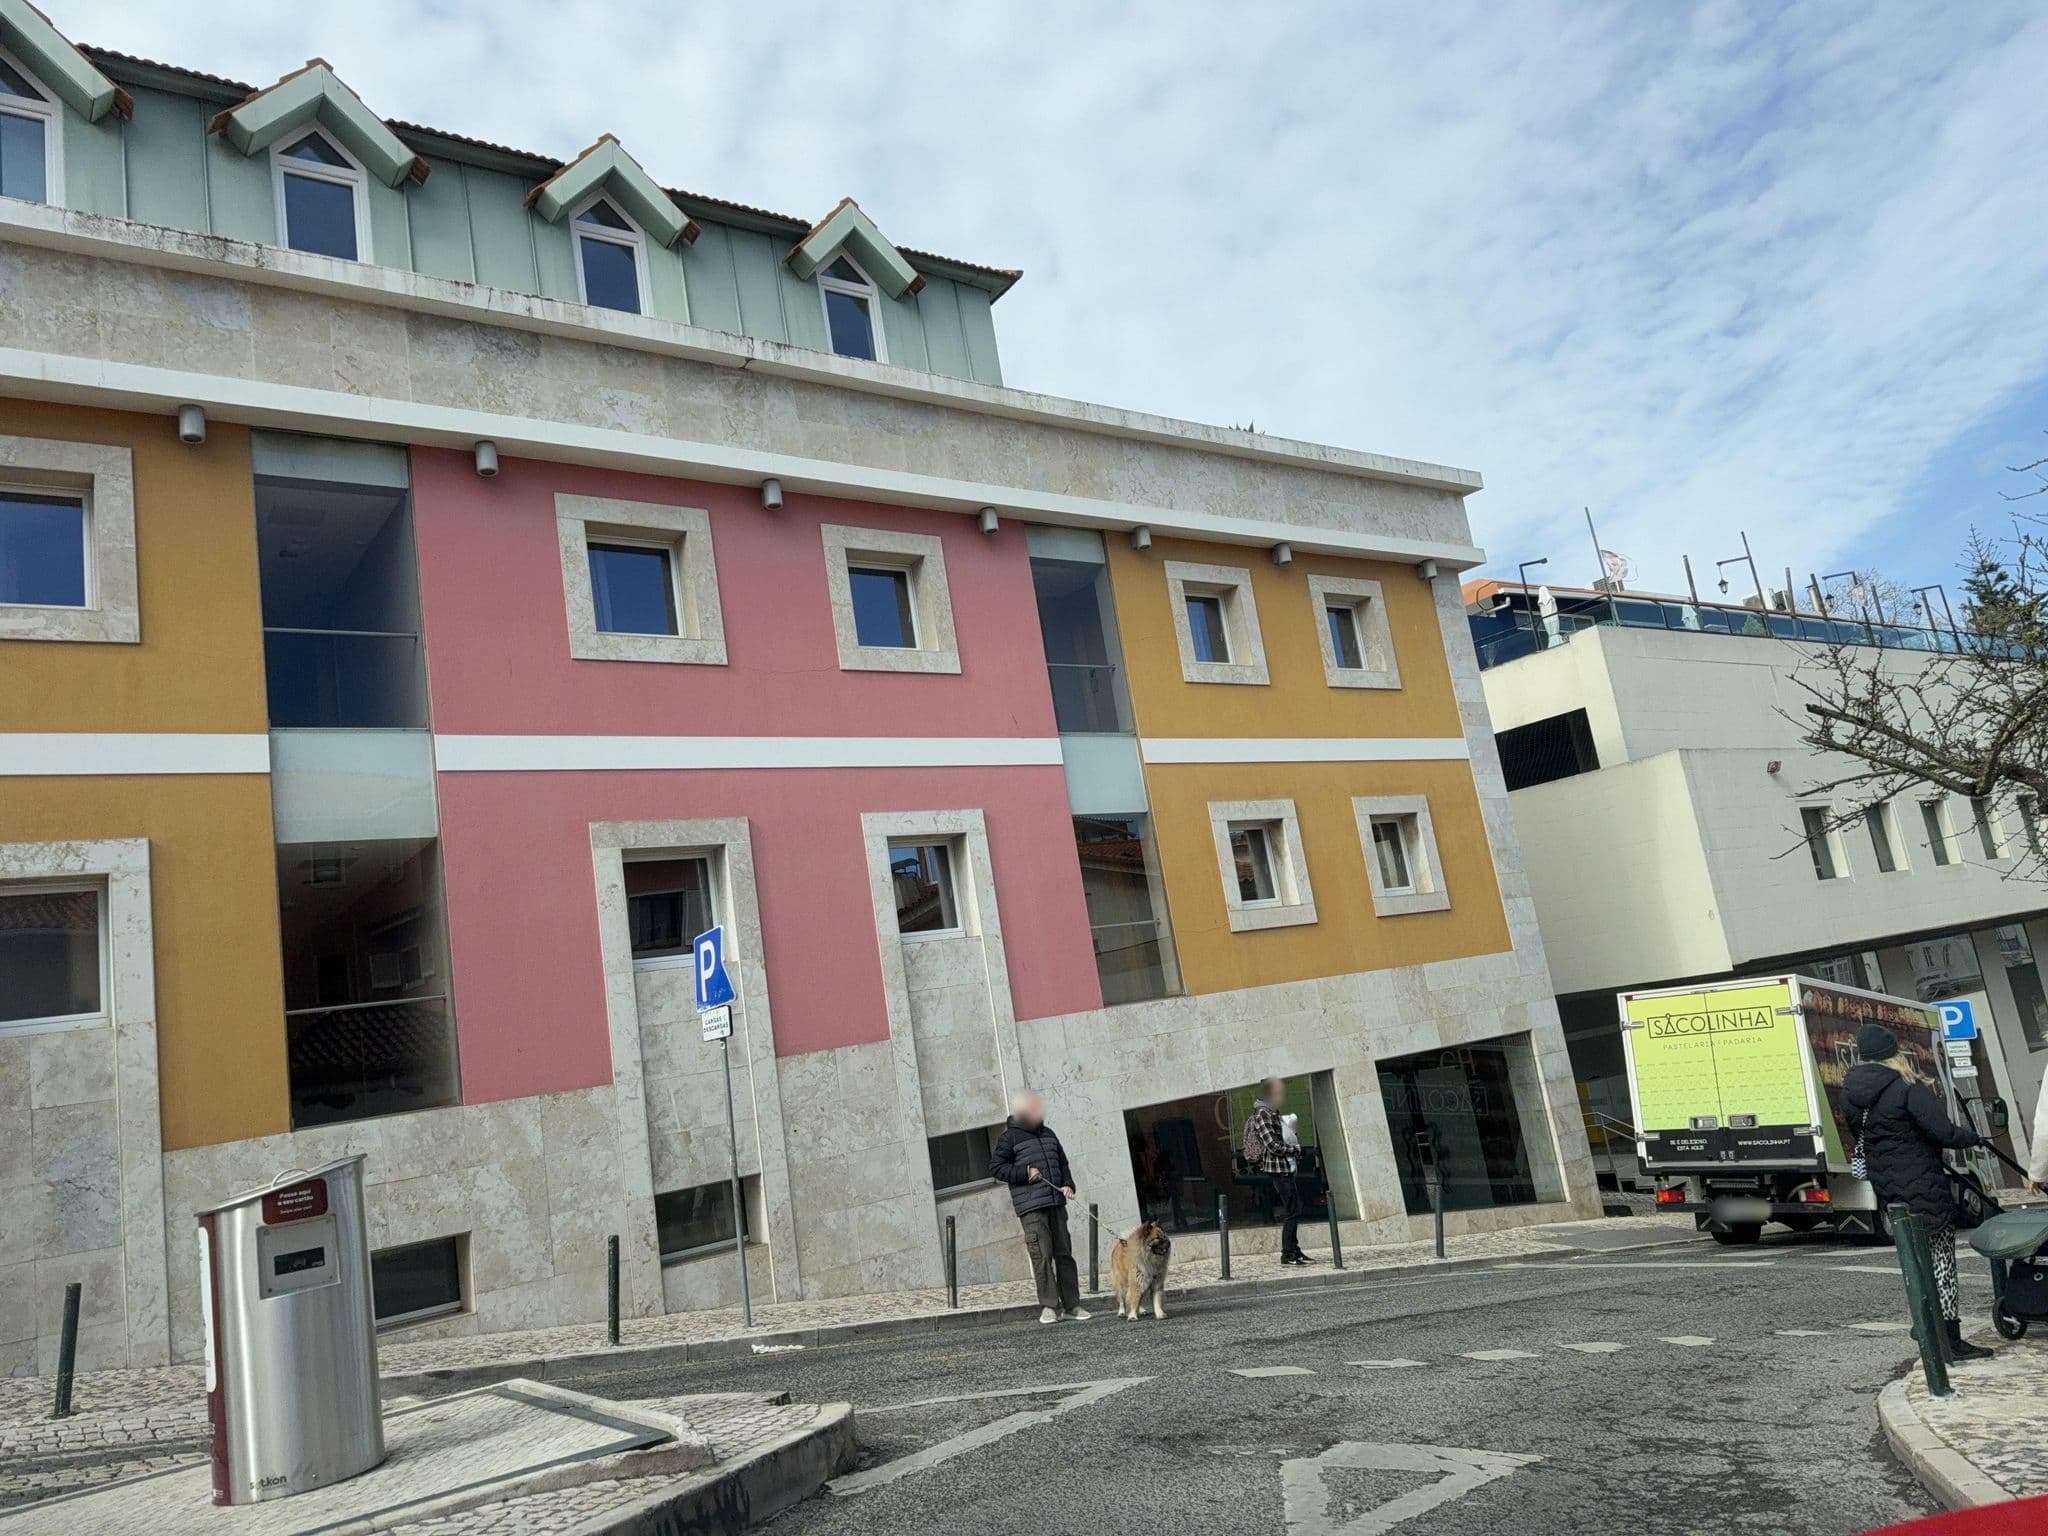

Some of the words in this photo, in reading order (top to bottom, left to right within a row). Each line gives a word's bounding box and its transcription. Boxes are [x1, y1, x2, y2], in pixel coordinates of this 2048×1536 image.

[700, 940, 716, 1002] P
[1940, 1006, 1963, 1035] P
[1663, 1040, 1715, 1051] PASTELARIA
[1723, 1036, 1763, 1046] PADARIA
